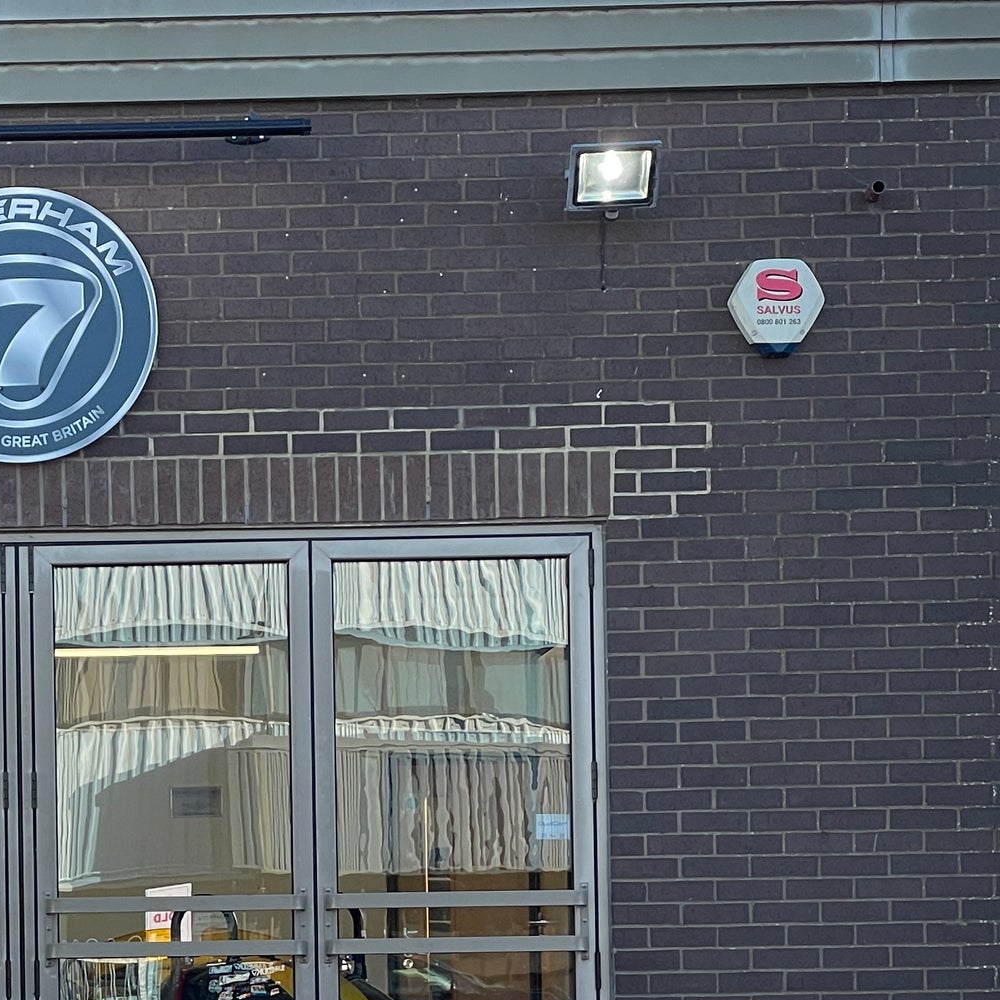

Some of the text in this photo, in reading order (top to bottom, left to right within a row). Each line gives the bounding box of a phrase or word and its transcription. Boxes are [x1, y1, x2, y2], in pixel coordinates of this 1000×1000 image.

[756, 305, 801, 315] SALVUS
[1, 433, 49, 448] GREAT
[52, 404, 106, 443] BRITAIN
